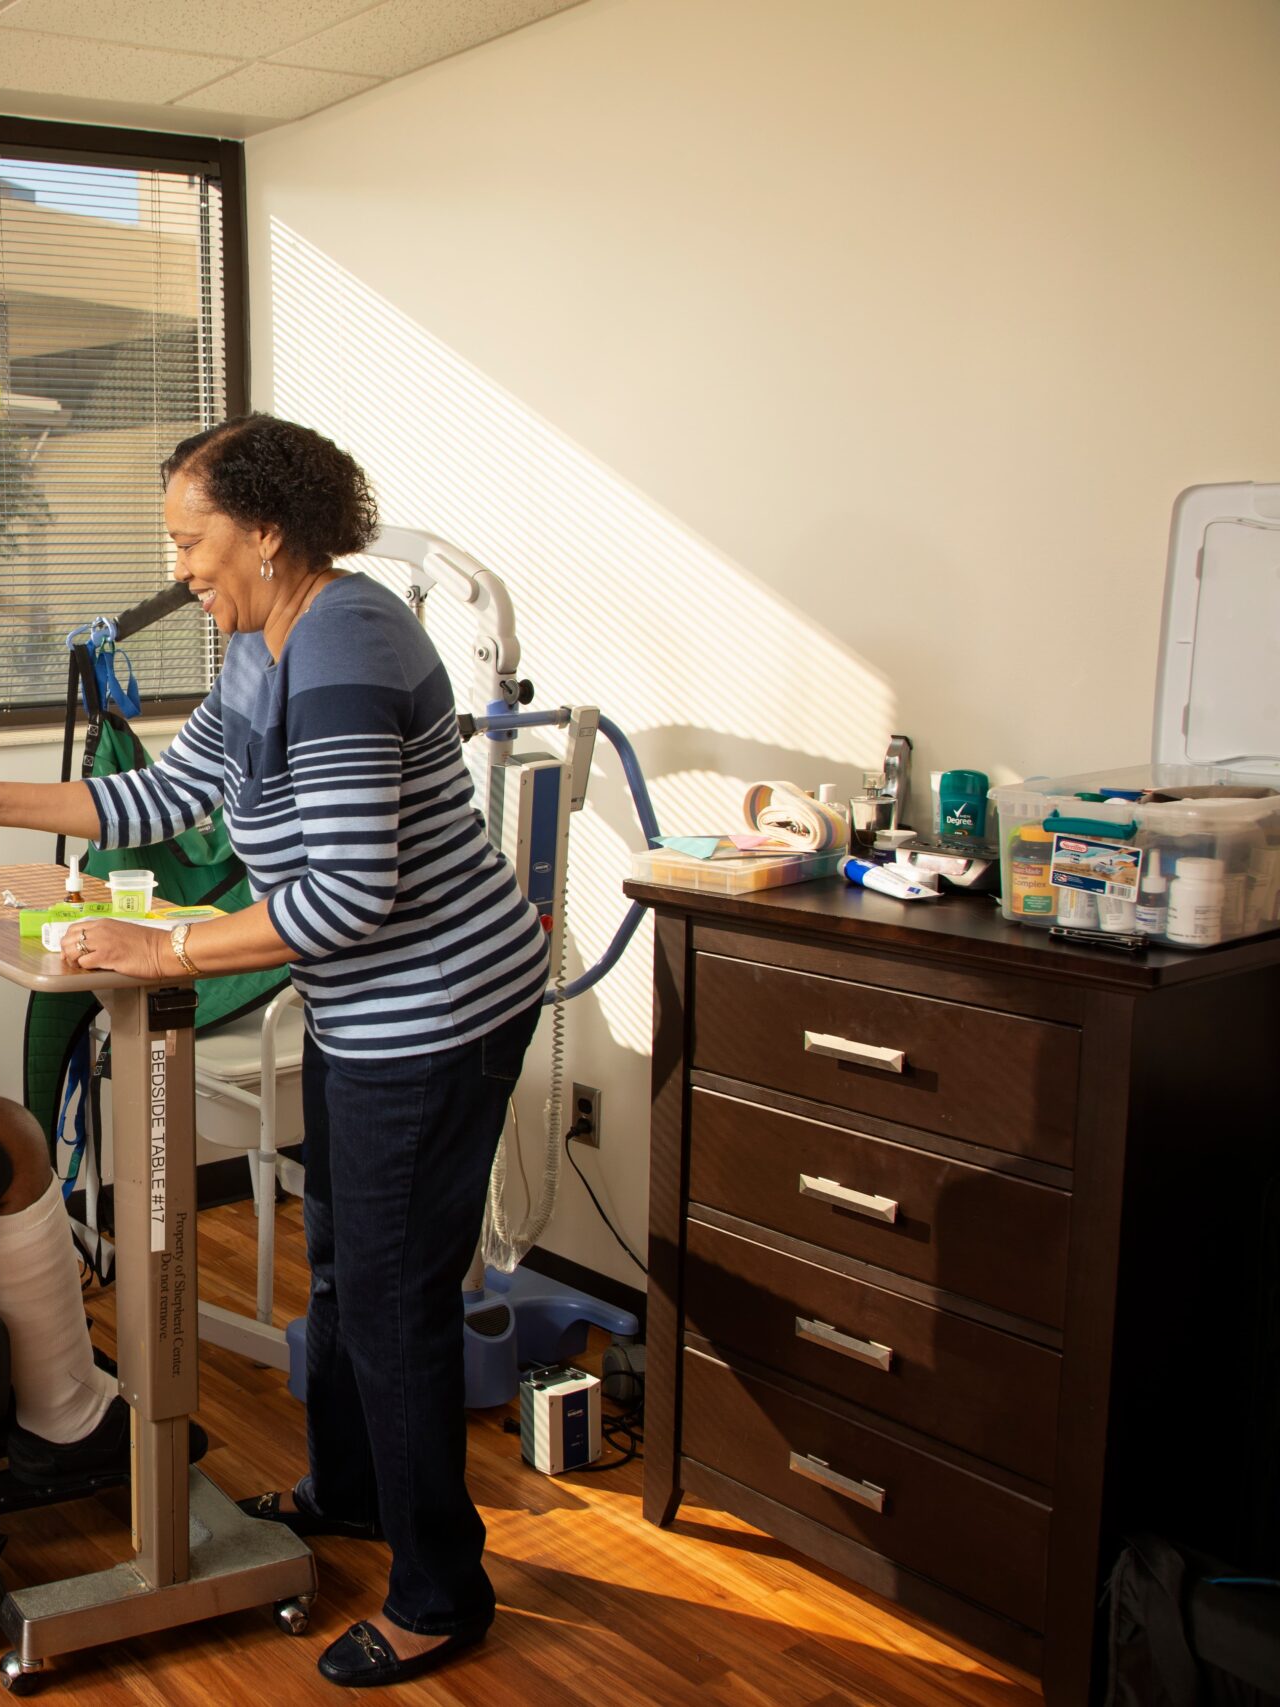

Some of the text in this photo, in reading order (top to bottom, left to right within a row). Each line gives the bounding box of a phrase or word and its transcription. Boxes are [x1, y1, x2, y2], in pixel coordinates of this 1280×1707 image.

[946, 815, 973, 826] Degree
[151, 1049, 165, 1224] BEDSIDE TABLE #17
[160, 1253, 171, 1343] Do not remove.
[171, 1212, 187, 1378] Property of Shepherd Center.
